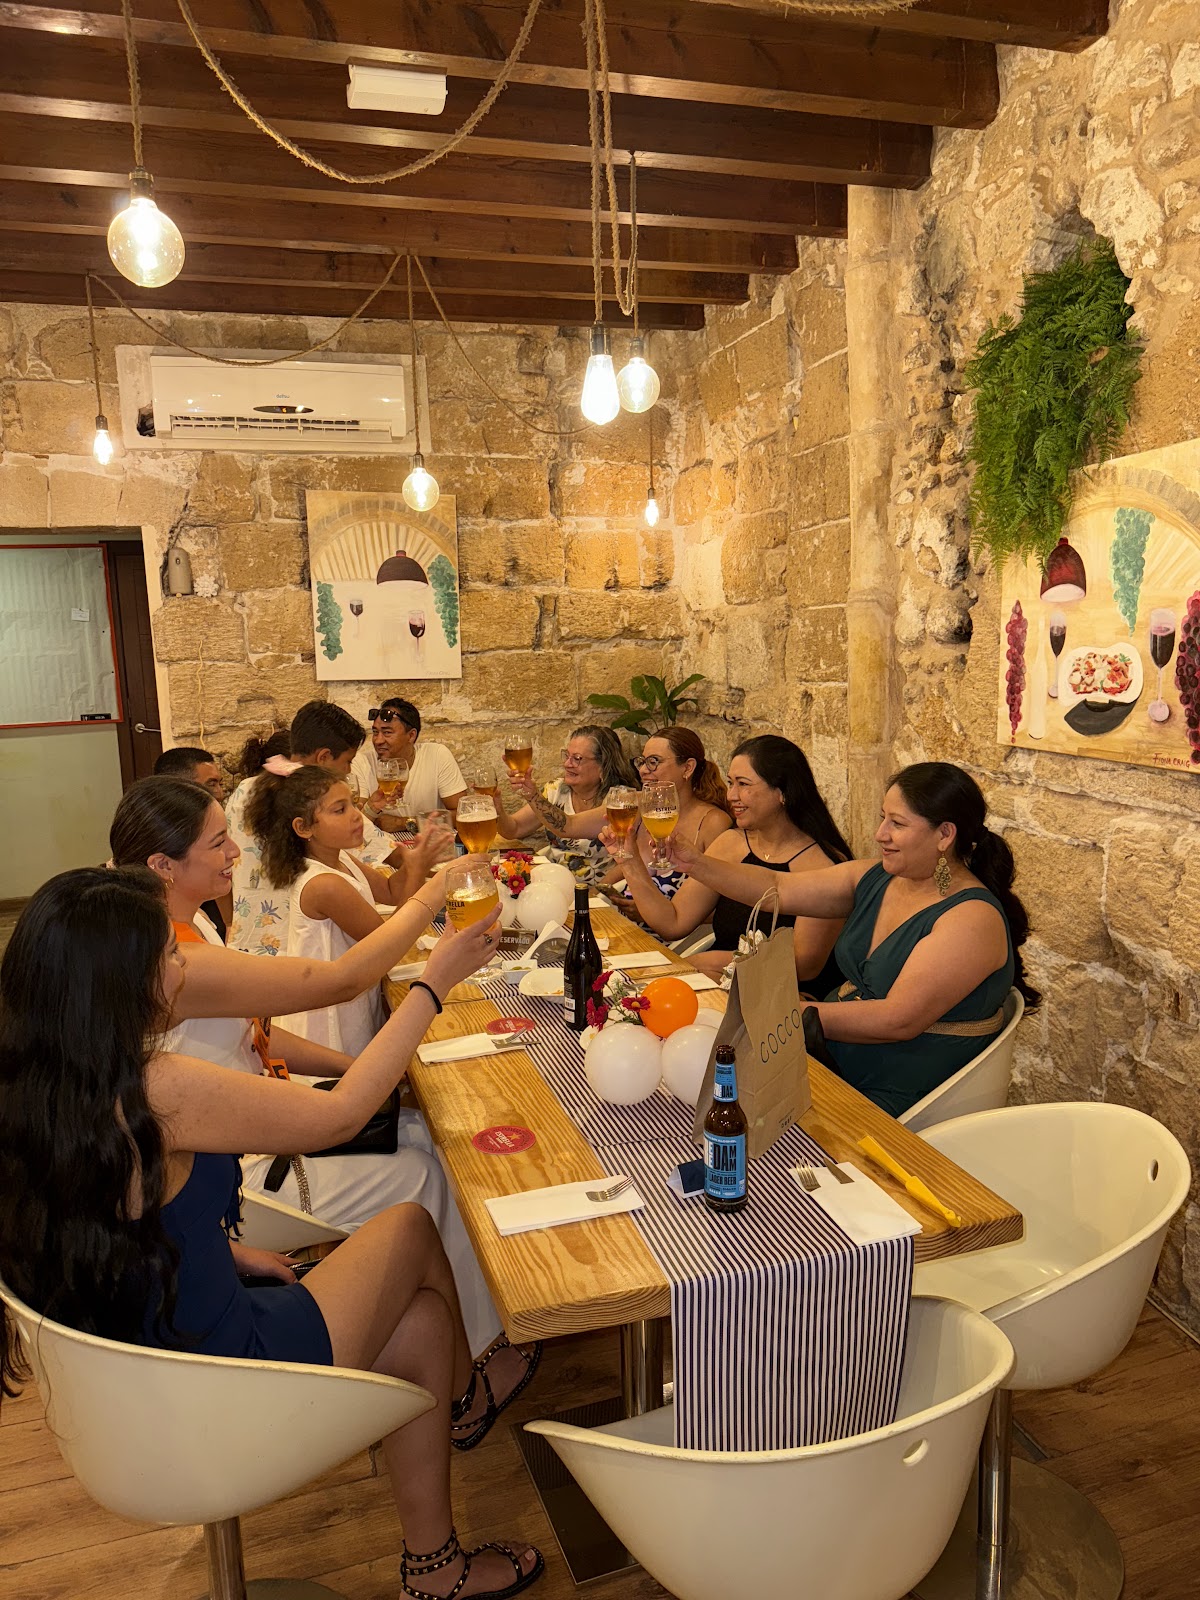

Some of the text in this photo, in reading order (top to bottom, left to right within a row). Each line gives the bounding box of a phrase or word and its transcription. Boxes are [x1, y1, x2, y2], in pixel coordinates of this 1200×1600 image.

[499, 936, 530, 944] ESERVADO
[760, 1008, 800, 1063] COCCO
[724, 1176, 737, 1186] BEER
